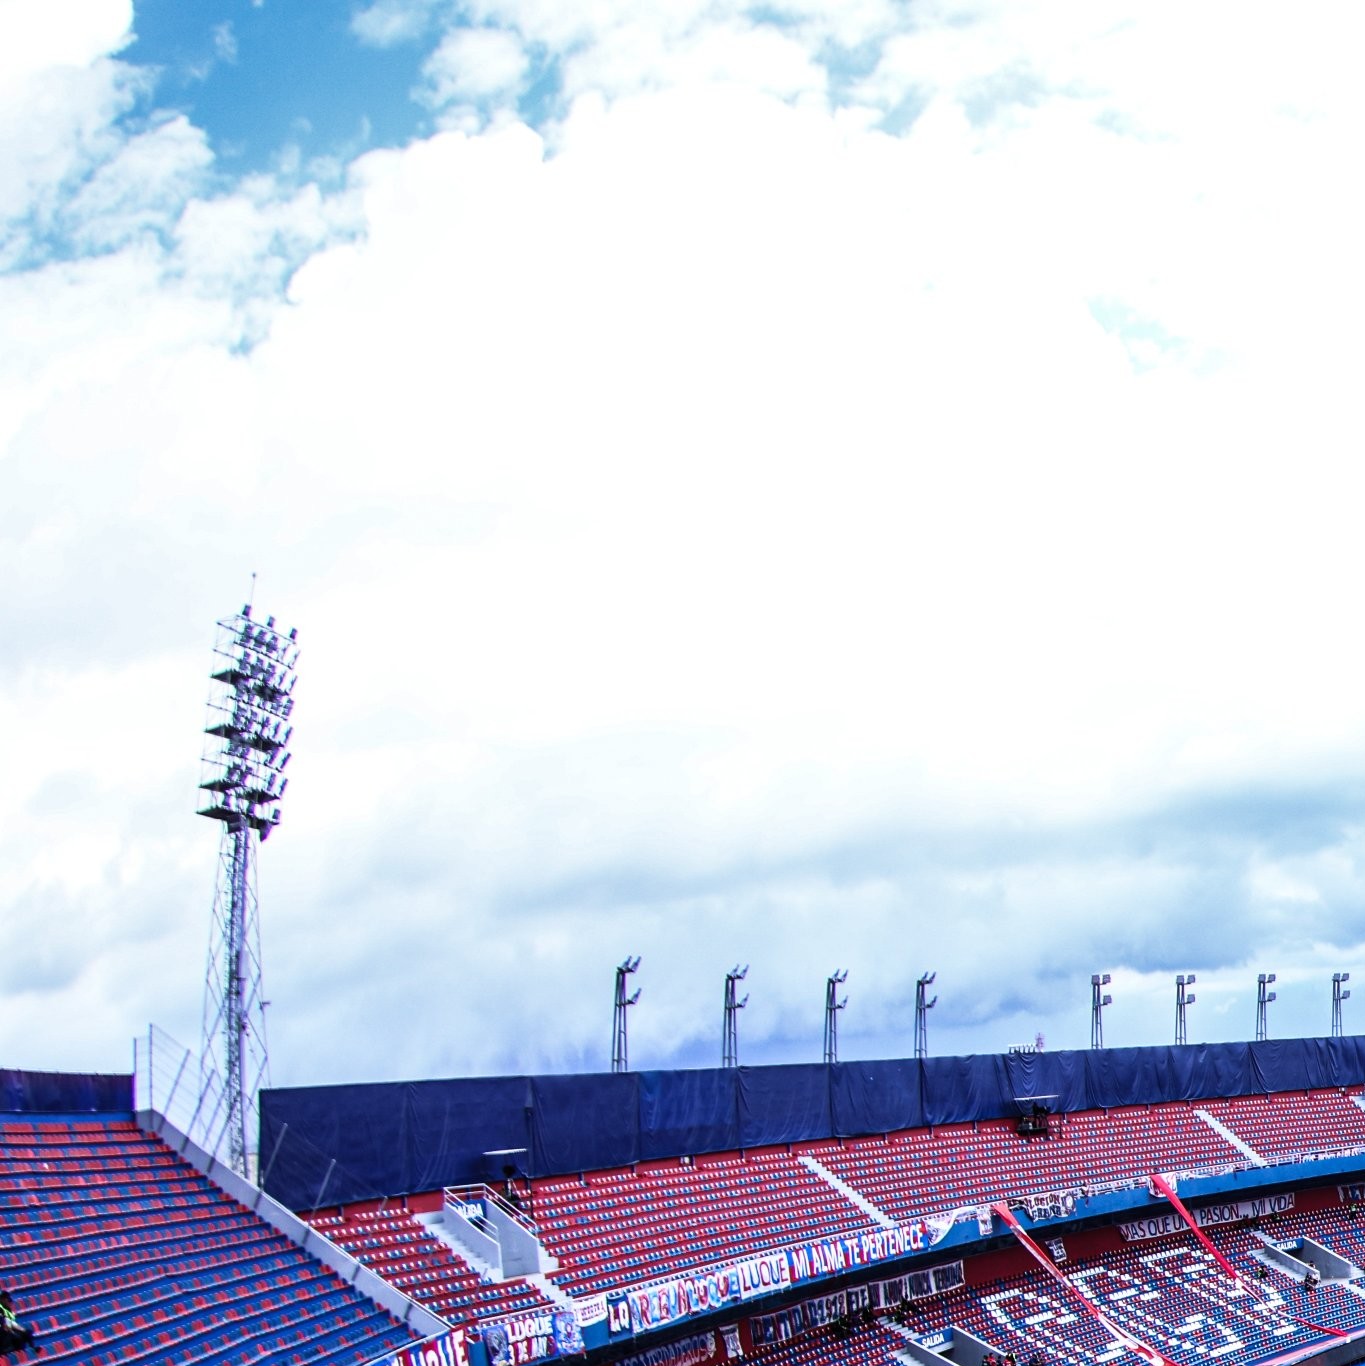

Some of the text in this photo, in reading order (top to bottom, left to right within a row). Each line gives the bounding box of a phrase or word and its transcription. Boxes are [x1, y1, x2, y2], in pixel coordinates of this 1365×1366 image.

[1147, 1217, 1171, 1237] QUE
[1252, 1200, 1266, 1217] MI
[1269, 1193, 1294, 1213] VIDA
[742, 1222, 923, 1292] LUQUE MI ALMA TE PERTENECE
[1276, 1240, 1297, 1251] SALIDA
[505, 1314, 553, 1344] LUQUE
[921, 1332, 945, 1348] SALIDA
